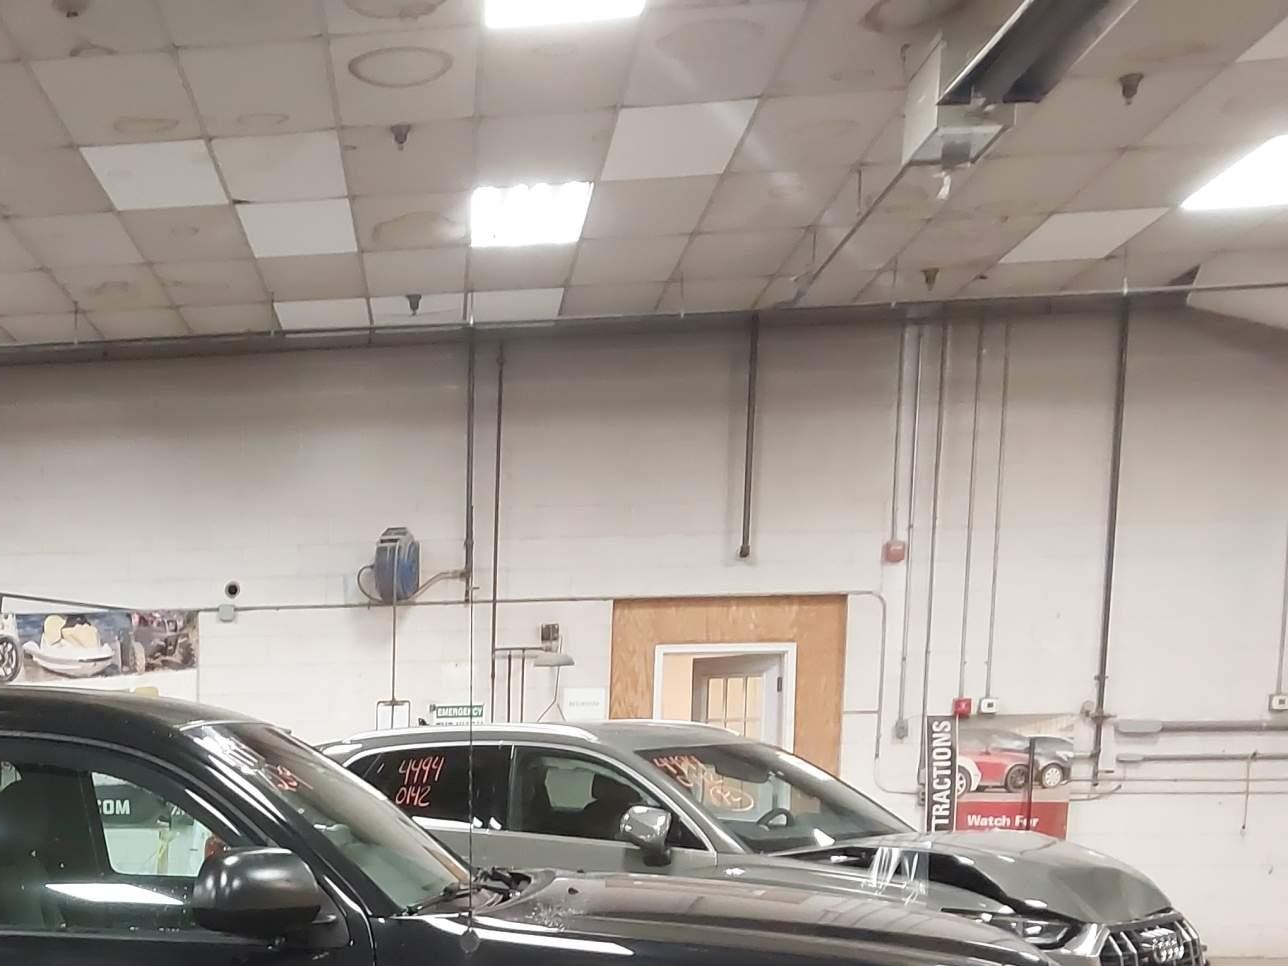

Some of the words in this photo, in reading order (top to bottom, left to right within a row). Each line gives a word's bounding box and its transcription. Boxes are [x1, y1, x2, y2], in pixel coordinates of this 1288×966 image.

[437, 707, 483, 717] EMERGENCY
[398, 756, 445, 785] 4494
[931, 720, 952, 832] TRACTIONS
[395, 785, 432, 807] 0142
[967, 814, 1011, 828] Watch
